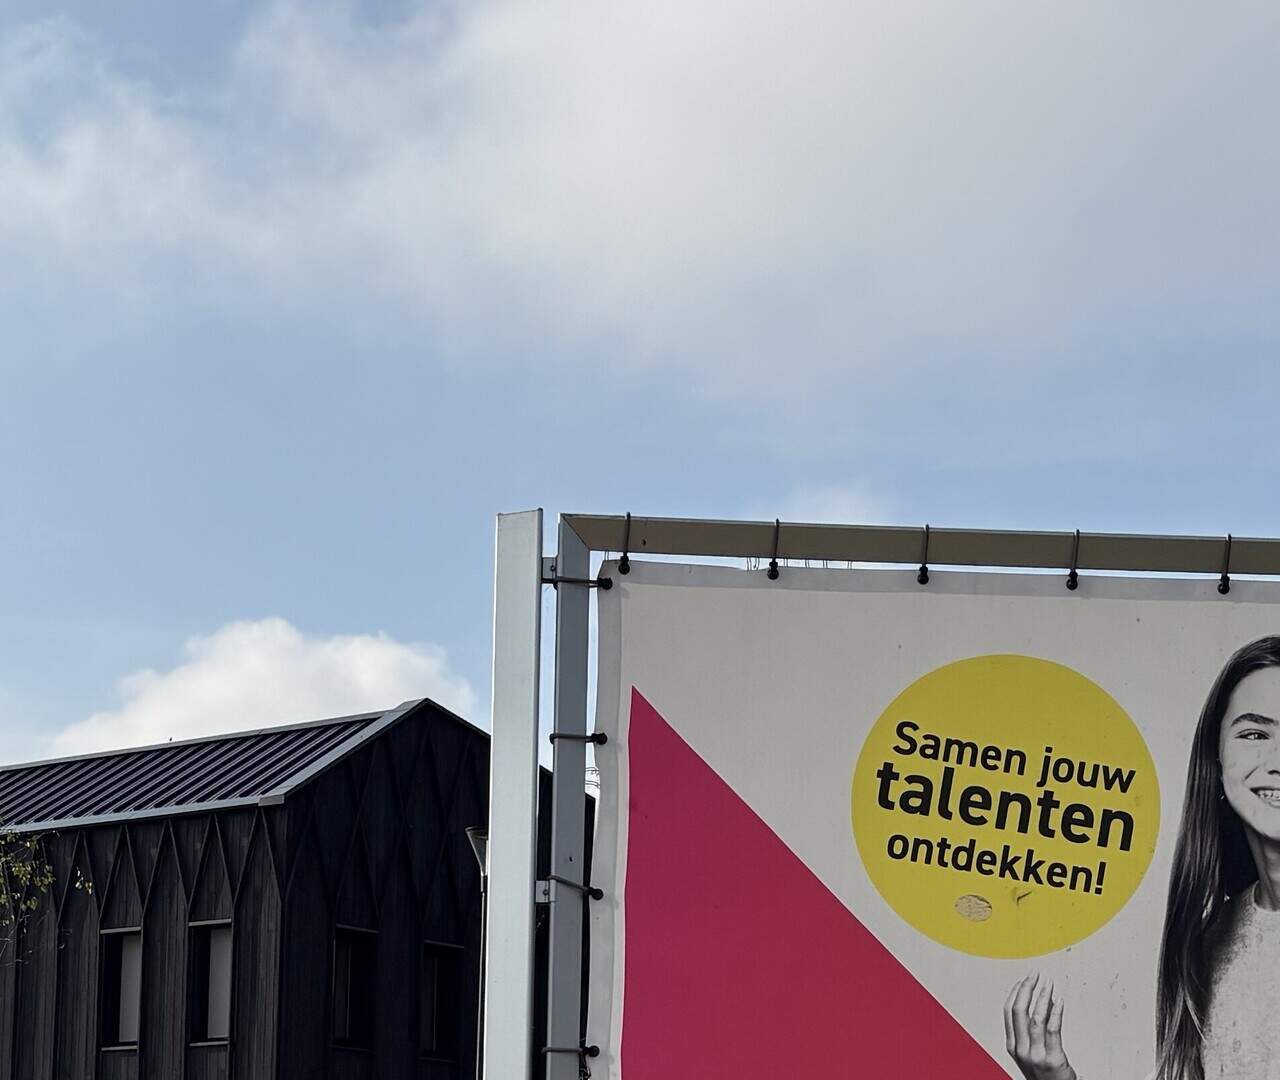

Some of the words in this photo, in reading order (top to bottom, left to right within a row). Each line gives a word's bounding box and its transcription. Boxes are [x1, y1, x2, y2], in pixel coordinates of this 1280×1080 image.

[892, 720, 1027, 776] Samen
[1036, 746, 1137, 794] jouw
[876, 761, 1135, 852] talenten
[886, 833, 1107, 896] ontdekken!
